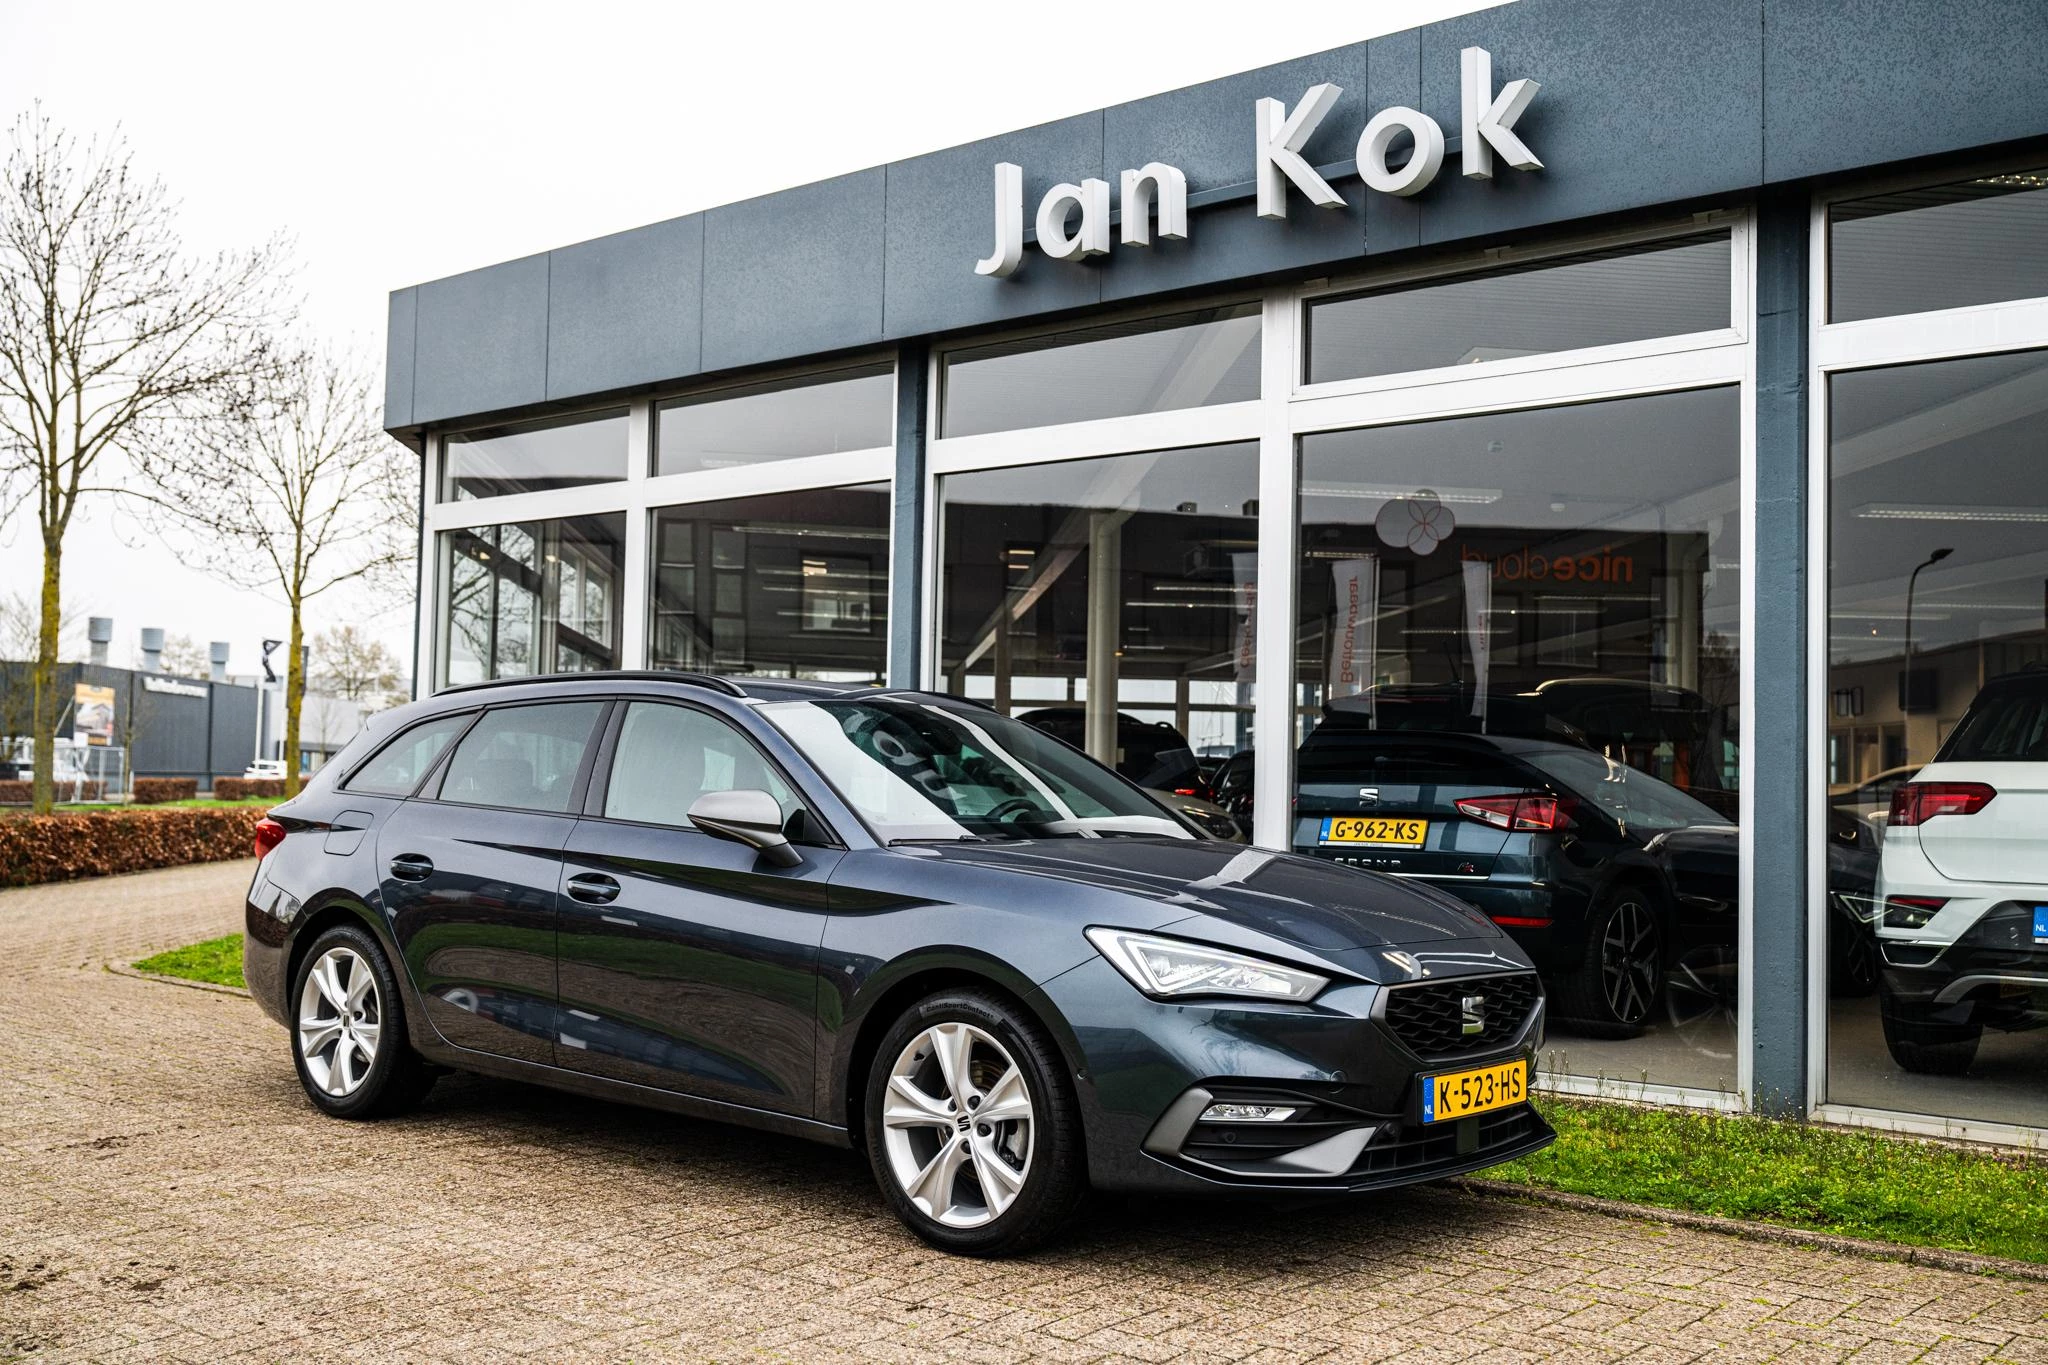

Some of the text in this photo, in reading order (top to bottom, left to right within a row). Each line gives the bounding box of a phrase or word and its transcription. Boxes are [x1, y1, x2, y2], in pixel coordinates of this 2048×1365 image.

[974, 45, 1545, 277] Jan Kok
[1320, 830, 1329, 838] NL
[1335, 820, 1420, 841] G-962-KS
[2035, 924, 2046, 932] NL
[1440, 1067, 1521, 1114] K-523-HS
[1424, 1104, 1433, 1115] NL
